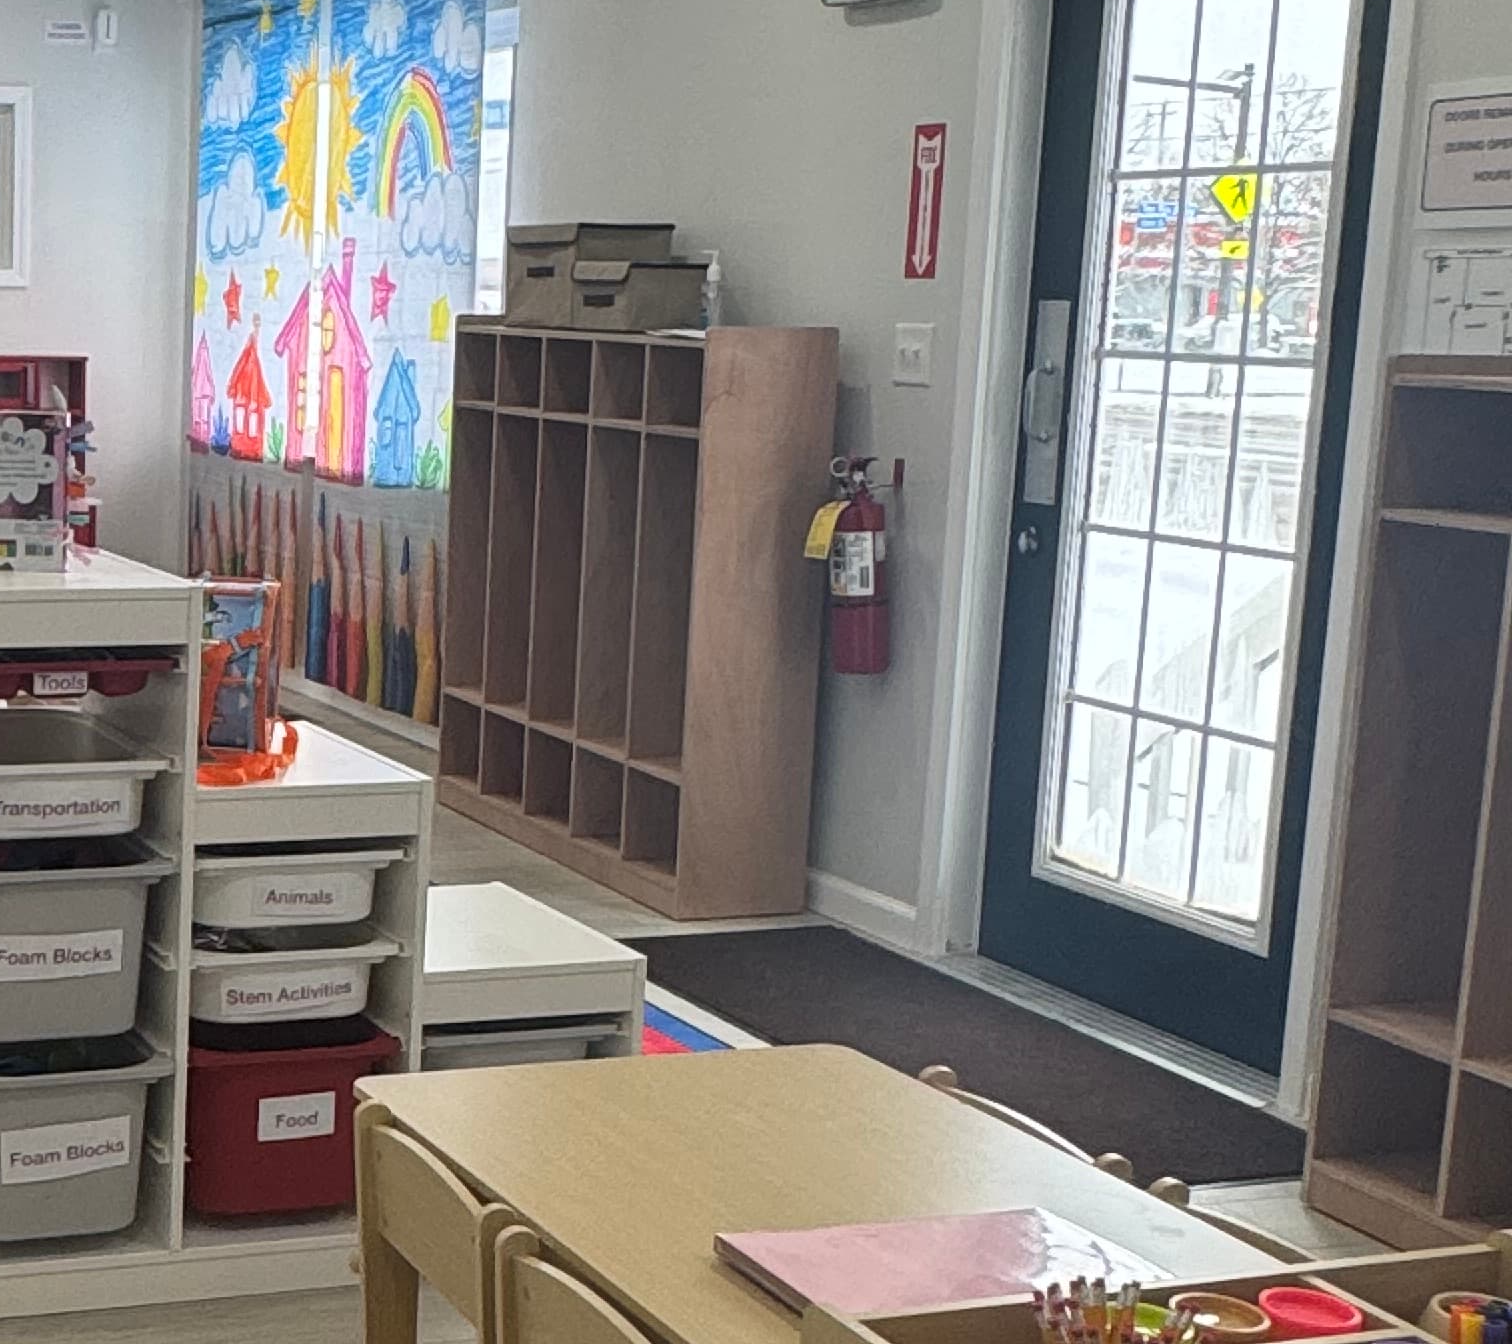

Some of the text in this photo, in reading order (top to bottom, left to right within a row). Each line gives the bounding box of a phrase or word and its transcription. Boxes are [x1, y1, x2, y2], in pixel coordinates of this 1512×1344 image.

[39, 674, 86, 689] Tools
[264, 888, 334, 905] Animals
[53, 947, 113, 964] Blocks
[226, 982, 352, 1005] Stem Activities
[275, 1110, 320, 1128] Food
[10, 1139, 124, 1168] Foam Blocks
